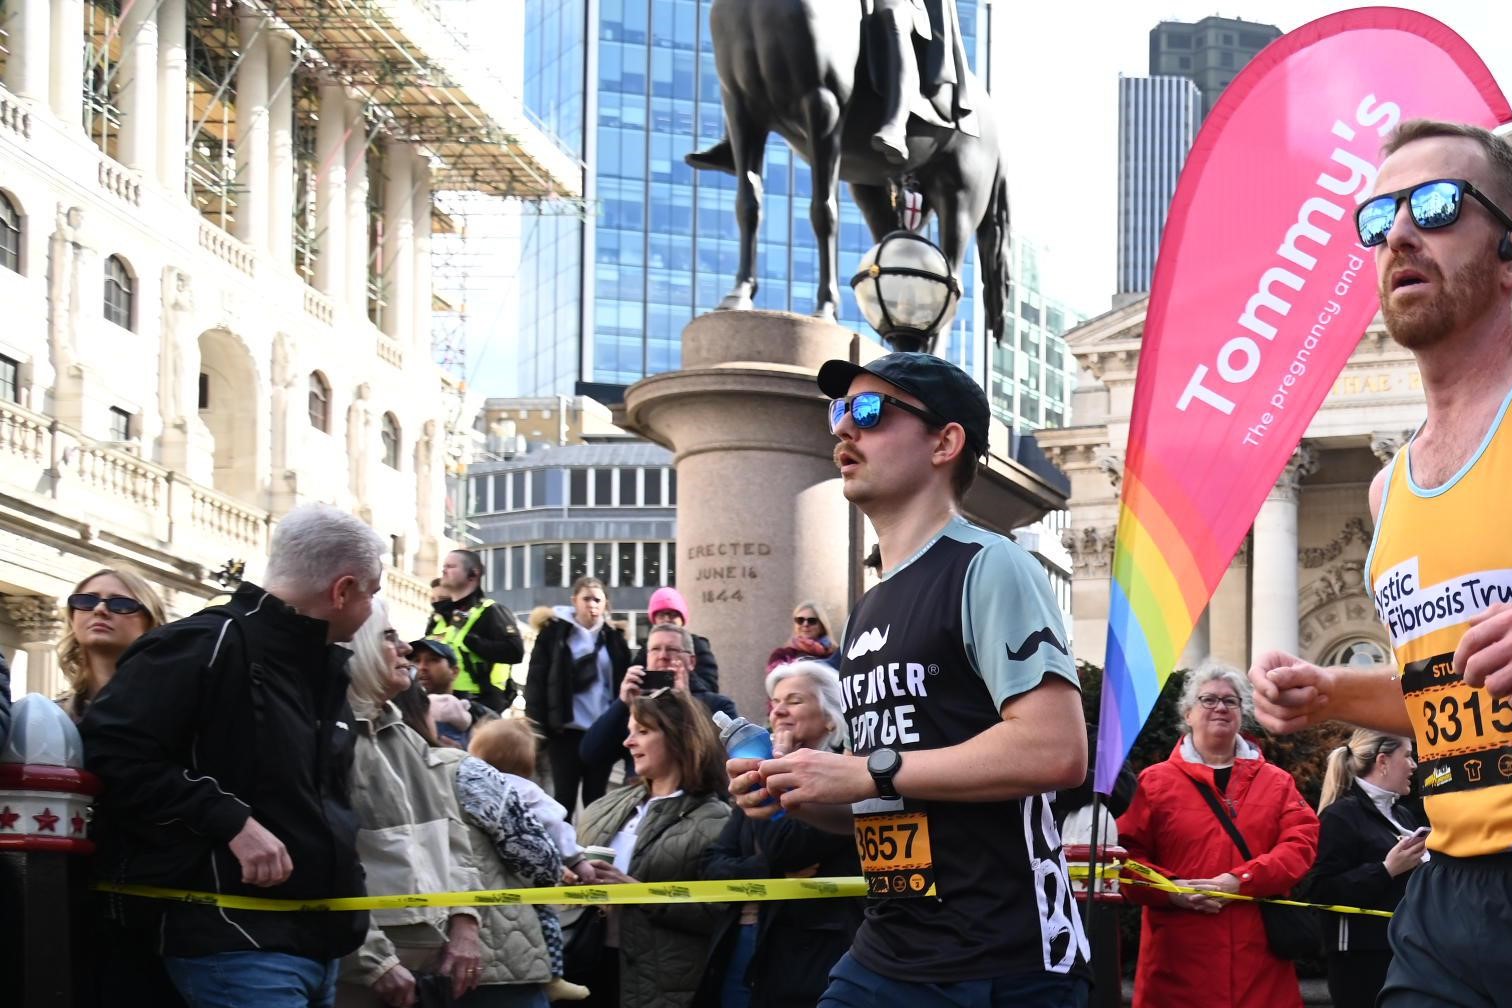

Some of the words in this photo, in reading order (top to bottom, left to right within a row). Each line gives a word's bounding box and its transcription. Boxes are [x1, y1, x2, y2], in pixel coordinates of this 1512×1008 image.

[1175, 93, 1401, 417] Tommy's
[1243, 410, 1274, 448] The
[1271, 300, 1341, 411] pregnancy
[1334, 252, 1365, 297] and
[688, 542, 771, 560] ERECTED
[696, 566, 737, 581] JUNE
[702, 589, 744, 603] 1844
[1388, 586, 1465, 639] Fibrosis
[856, 823, 919, 862] 3657
